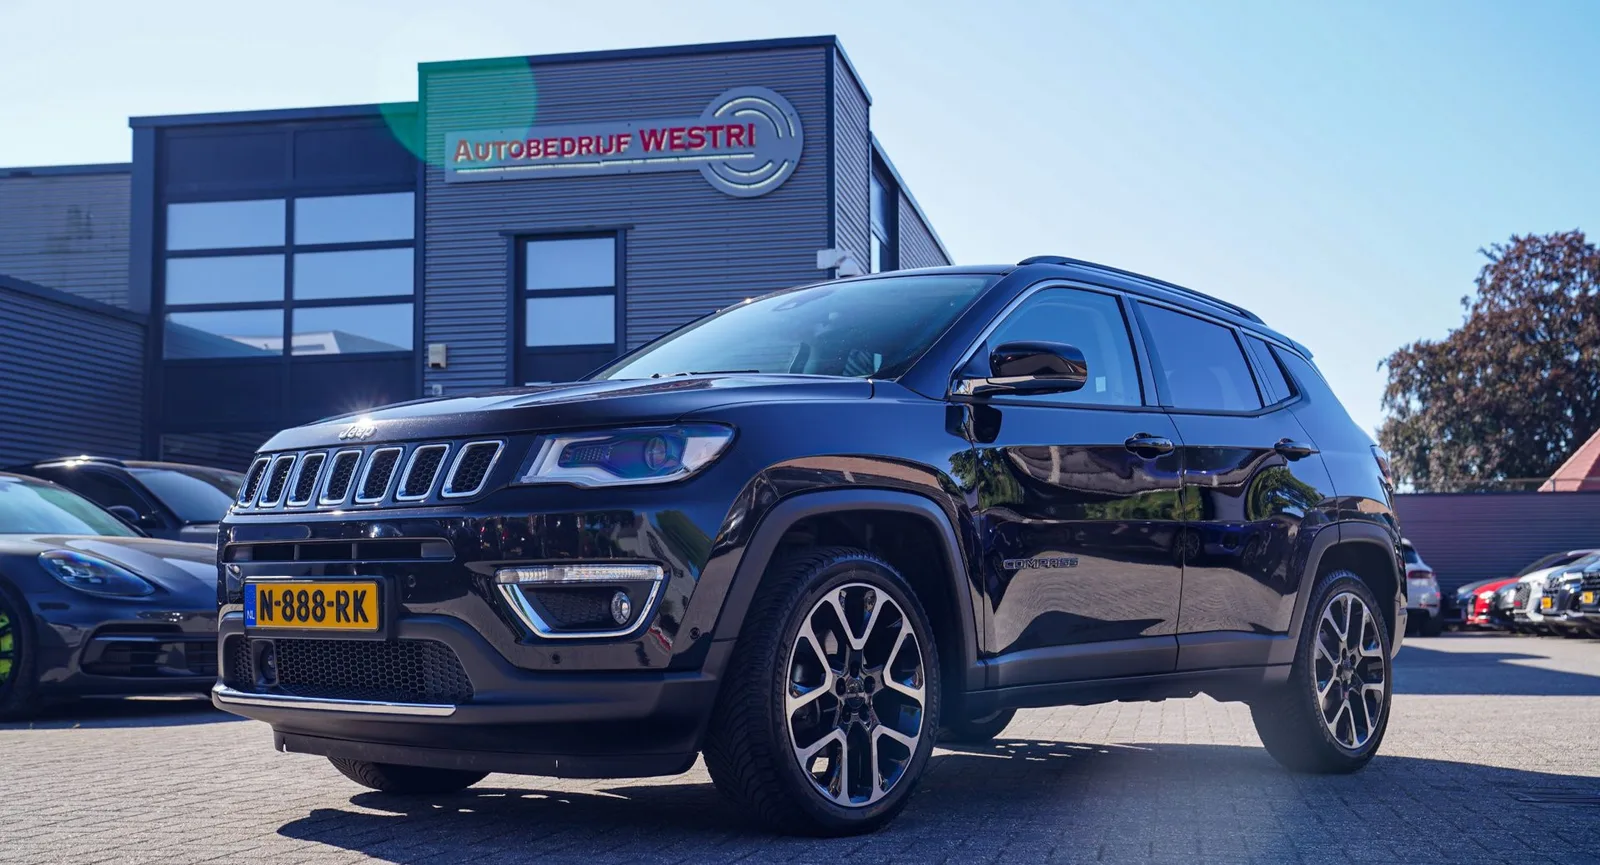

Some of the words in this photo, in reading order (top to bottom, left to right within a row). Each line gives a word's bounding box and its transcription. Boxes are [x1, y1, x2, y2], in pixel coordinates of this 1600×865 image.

[638, 122, 756, 152] WESTRI
[338, 424, 377, 441] Jeep
[1003, 558, 1079, 570] COMPASS
[259, 589, 369, 624] N-888-RK
